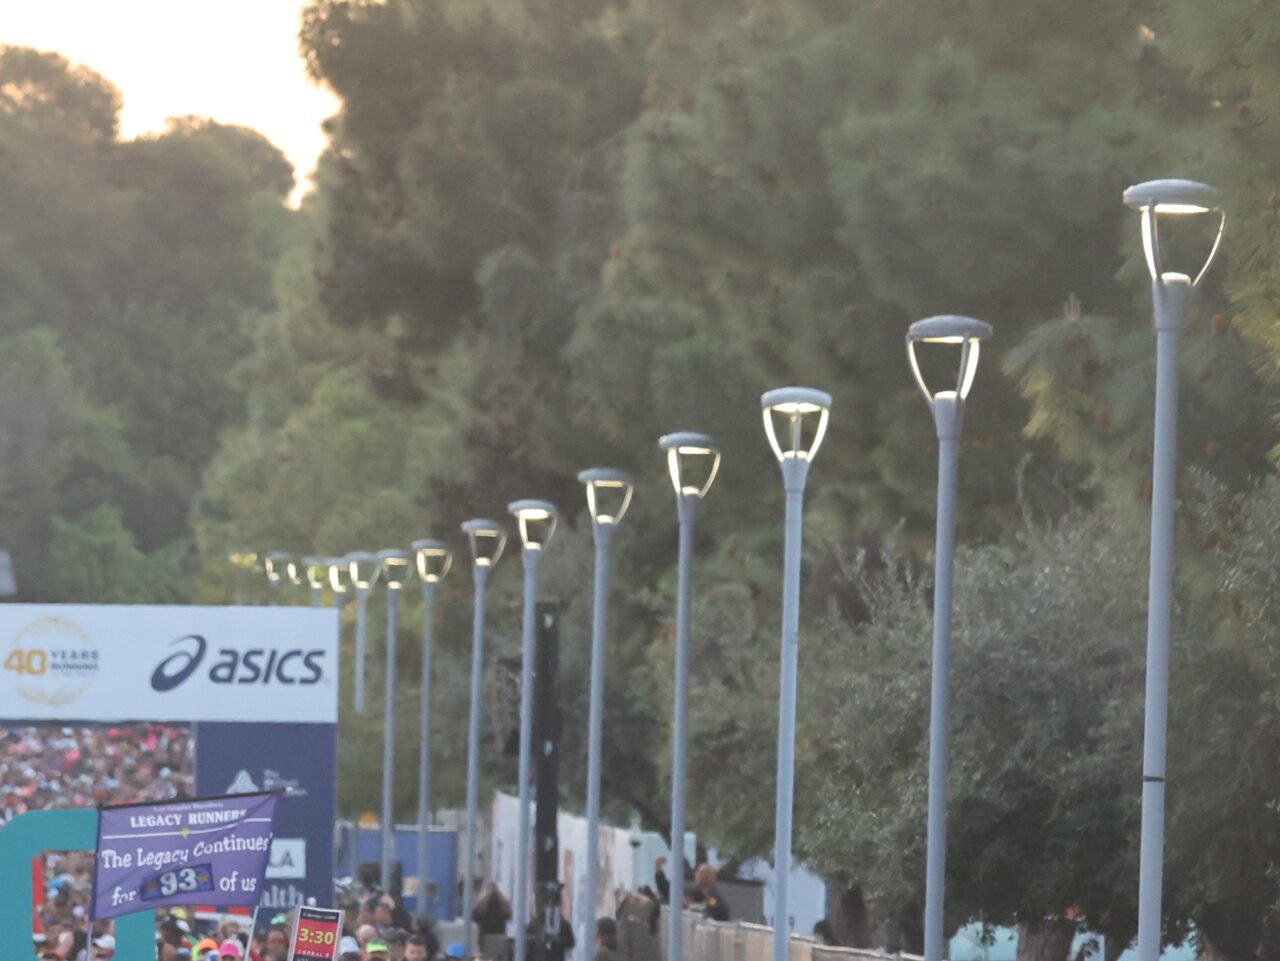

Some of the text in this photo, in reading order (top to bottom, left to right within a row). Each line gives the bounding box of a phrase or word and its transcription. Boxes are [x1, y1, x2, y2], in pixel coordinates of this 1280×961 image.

[3, 649, 48, 676] 40
[51, 650, 100, 661] YEARS
[129, 814, 182, 829] LEGACY
[101, 849, 132, 870] The
[136, 845, 189, 871] Legacy
[111, 867, 257, 907] for 93 of us
[298, 928, 335, 945] 3:30
